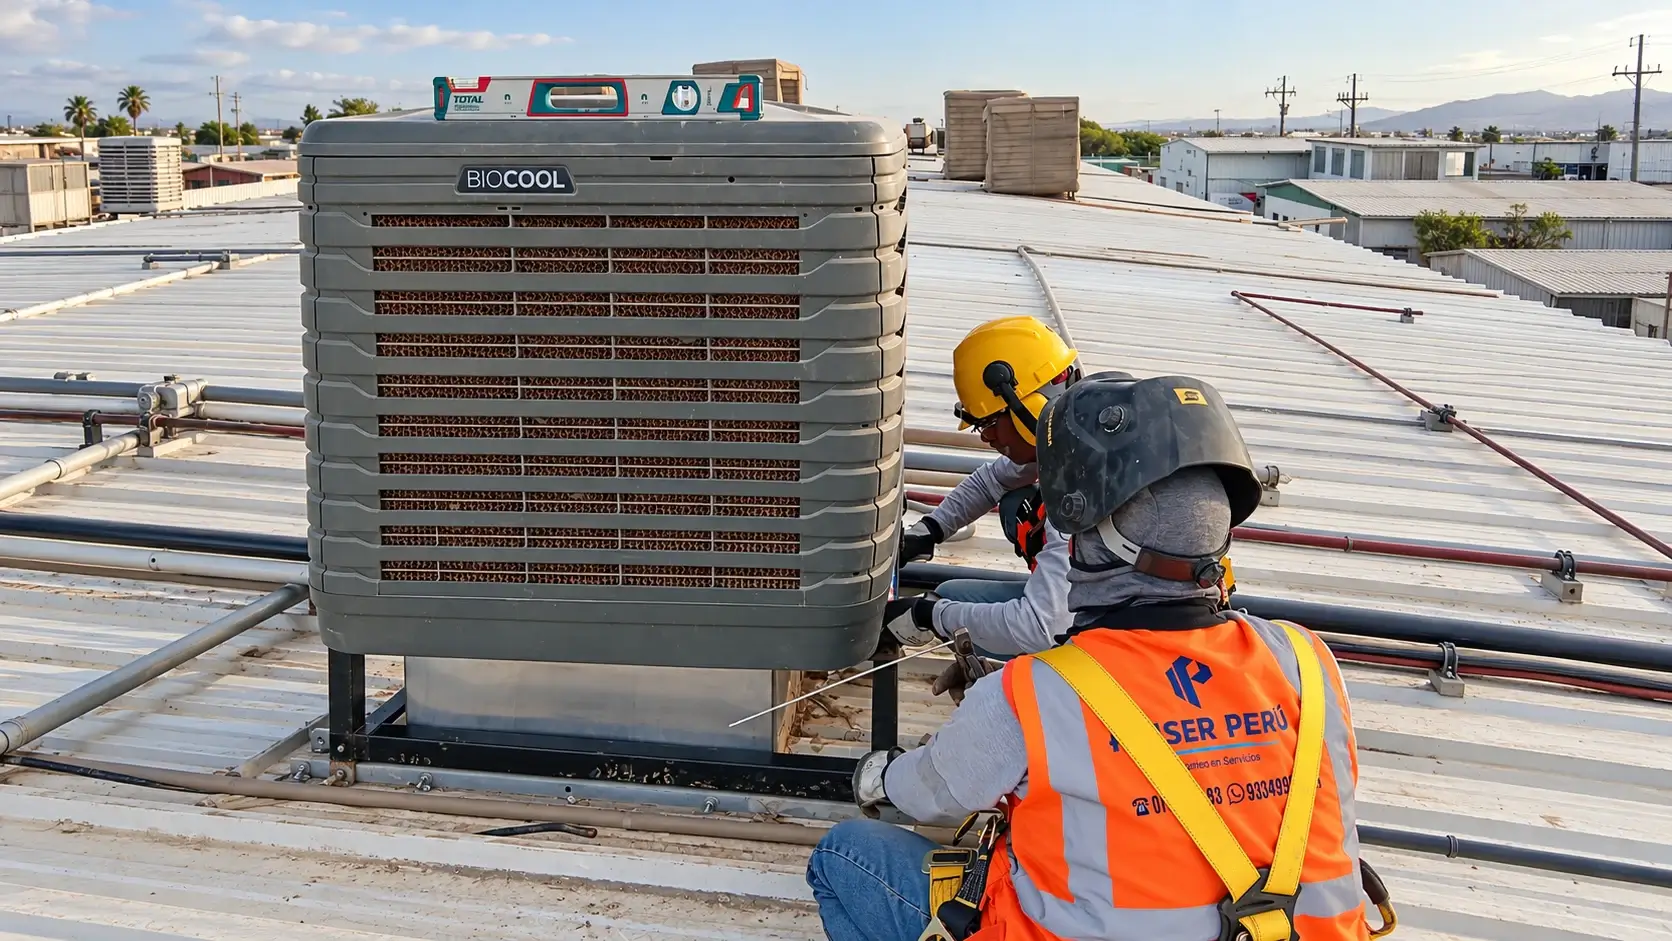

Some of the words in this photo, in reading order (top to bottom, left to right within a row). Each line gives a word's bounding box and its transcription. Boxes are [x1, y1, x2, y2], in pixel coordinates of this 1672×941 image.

[453, 95, 484, 104] TOTAL
[467, 169, 565, 188] BIOCOOL
[1211, 759, 1221, 767] en
[1223, 753, 1261, 766] Servicios
